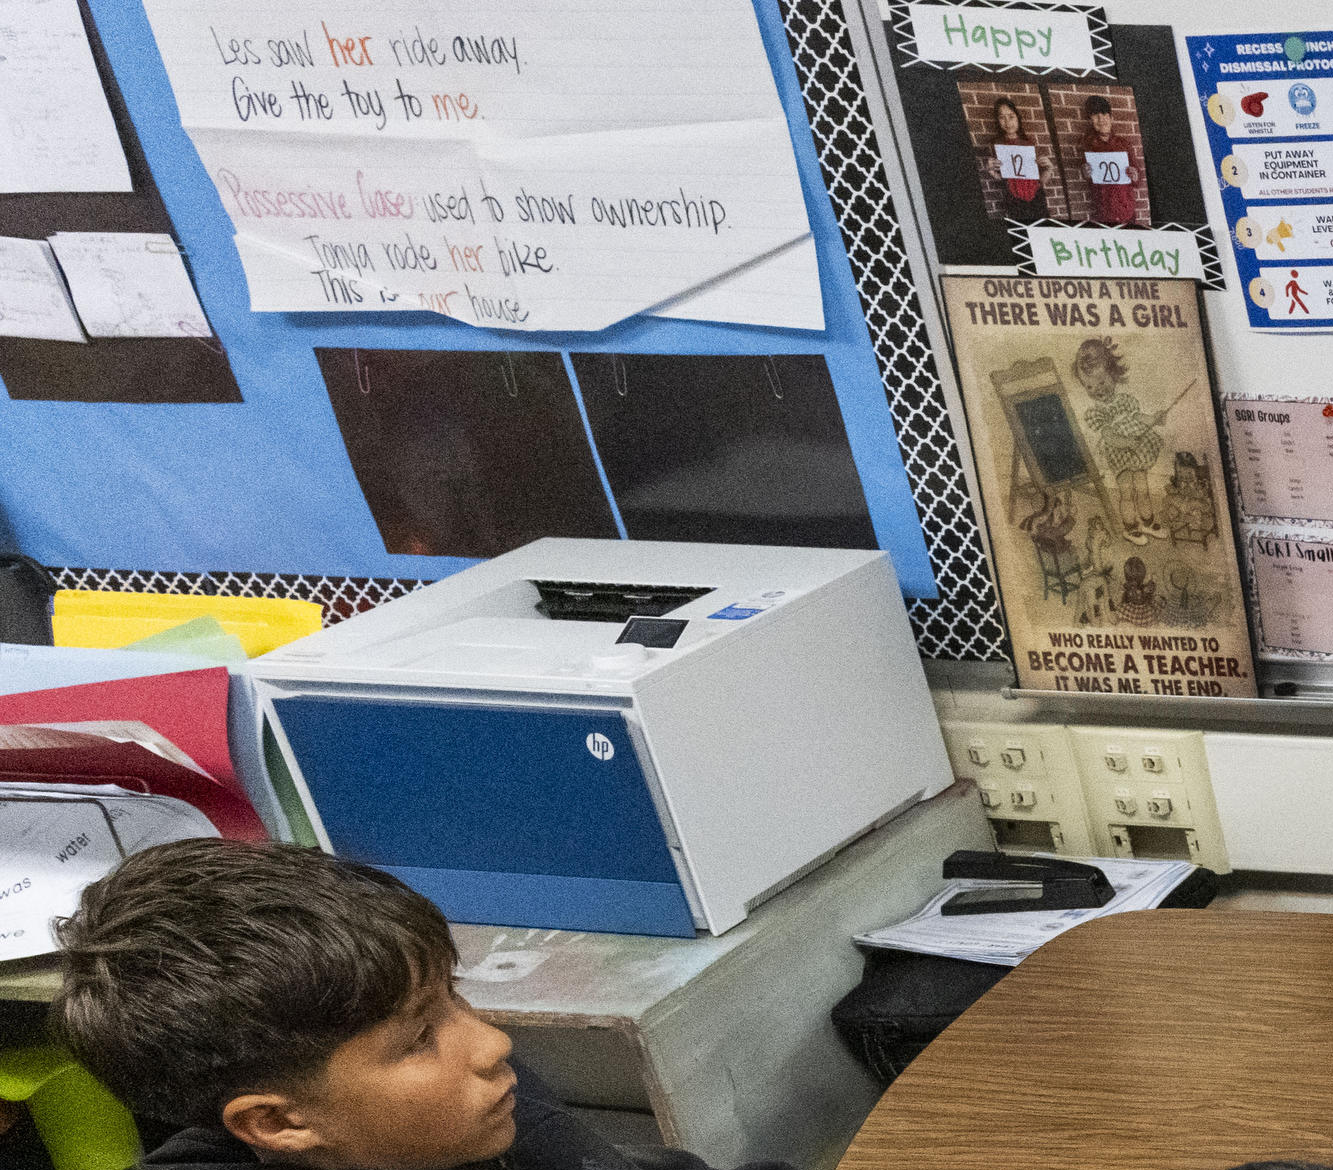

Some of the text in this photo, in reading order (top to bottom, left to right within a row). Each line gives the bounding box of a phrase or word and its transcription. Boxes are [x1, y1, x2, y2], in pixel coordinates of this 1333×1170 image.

[211, 22, 527, 74] Les saw her ride away.
[943, 14, 1052, 58] Happy
[232, 77, 485, 129] Give the toy to me.
[1011, 154, 1024, 178] 12
[1100, 161, 1120, 183] 20
[218, 168, 352, 219] Possessive
[424, 188, 474, 225] used
[481, 178, 504, 223] to
[516, 187, 574, 225] show
[591, 187, 732, 239] ownership.
[304, 234, 559, 277] Tonya rode her bike.
[1050, 238, 1179, 275] Birthday
[983, 280, 1034, 299] ONCE
[1041, 280, 1093, 299] UPON
[1116, 281, 1160, 300] TIME
[965, 302, 1039, 326] THERE
[1047, 302, 1098, 326] WAS
[1132, 305, 1188, 327] GIRL
[1048, 632, 1219, 651] WHO REALLY WANTED TO
[1028, 651, 1117, 673] BECOME
[1144, 653, 1248, 678] TEACHER.
[1072, 675, 1113, 694] WAS
[1119, 677, 1146, 695] ME.
[1151, 678, 1184, 695] THE
[1187, 680, 1227, 697] END.
[55, 832, 92, 864] water
